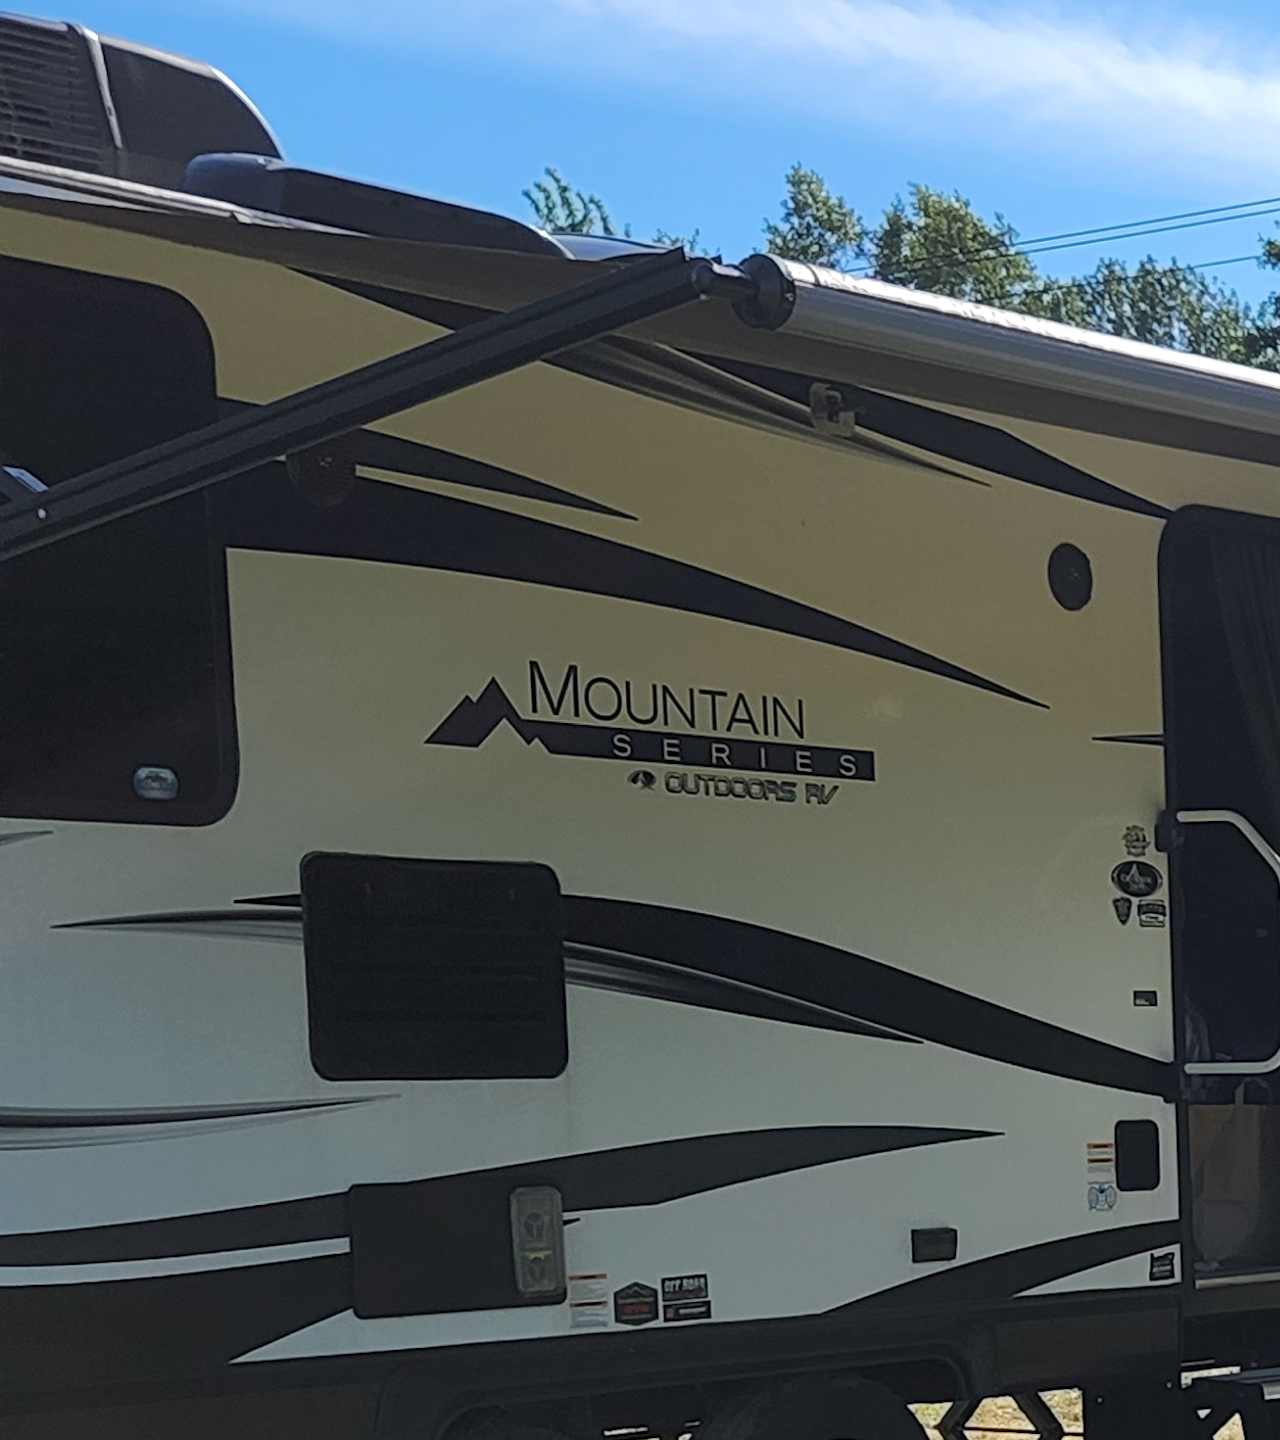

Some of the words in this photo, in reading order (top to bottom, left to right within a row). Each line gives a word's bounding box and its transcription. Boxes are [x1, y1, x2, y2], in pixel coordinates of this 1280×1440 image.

[612, 734, 858, 777] SERIES
[664, 771, 798, 804] OUTDOORS
[804, 782, 840, 805] RV
